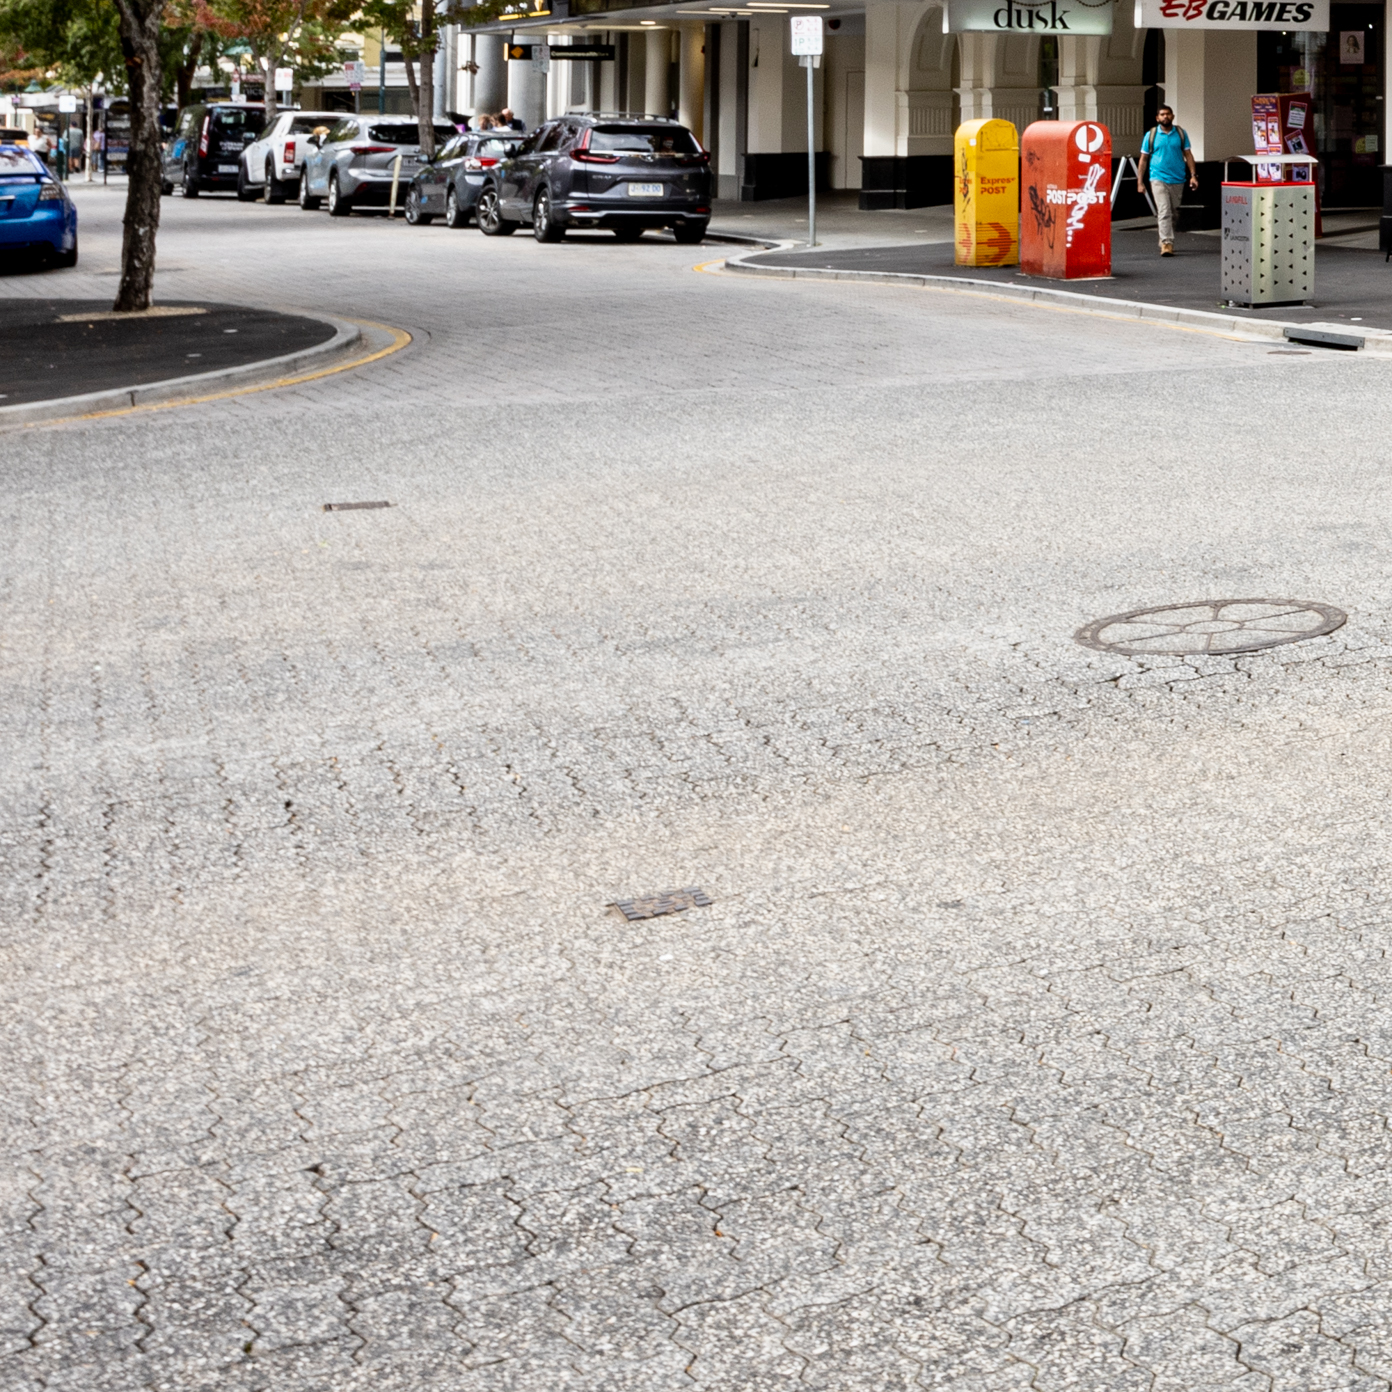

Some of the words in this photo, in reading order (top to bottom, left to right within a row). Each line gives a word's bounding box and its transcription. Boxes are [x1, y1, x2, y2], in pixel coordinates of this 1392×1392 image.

[1205, 0, 1316, 24] GAMES
[980, 186, 1007, 195] POST
[1046, 189, 1067, 204] POST
[1066, 191, 1107, 205] POST
